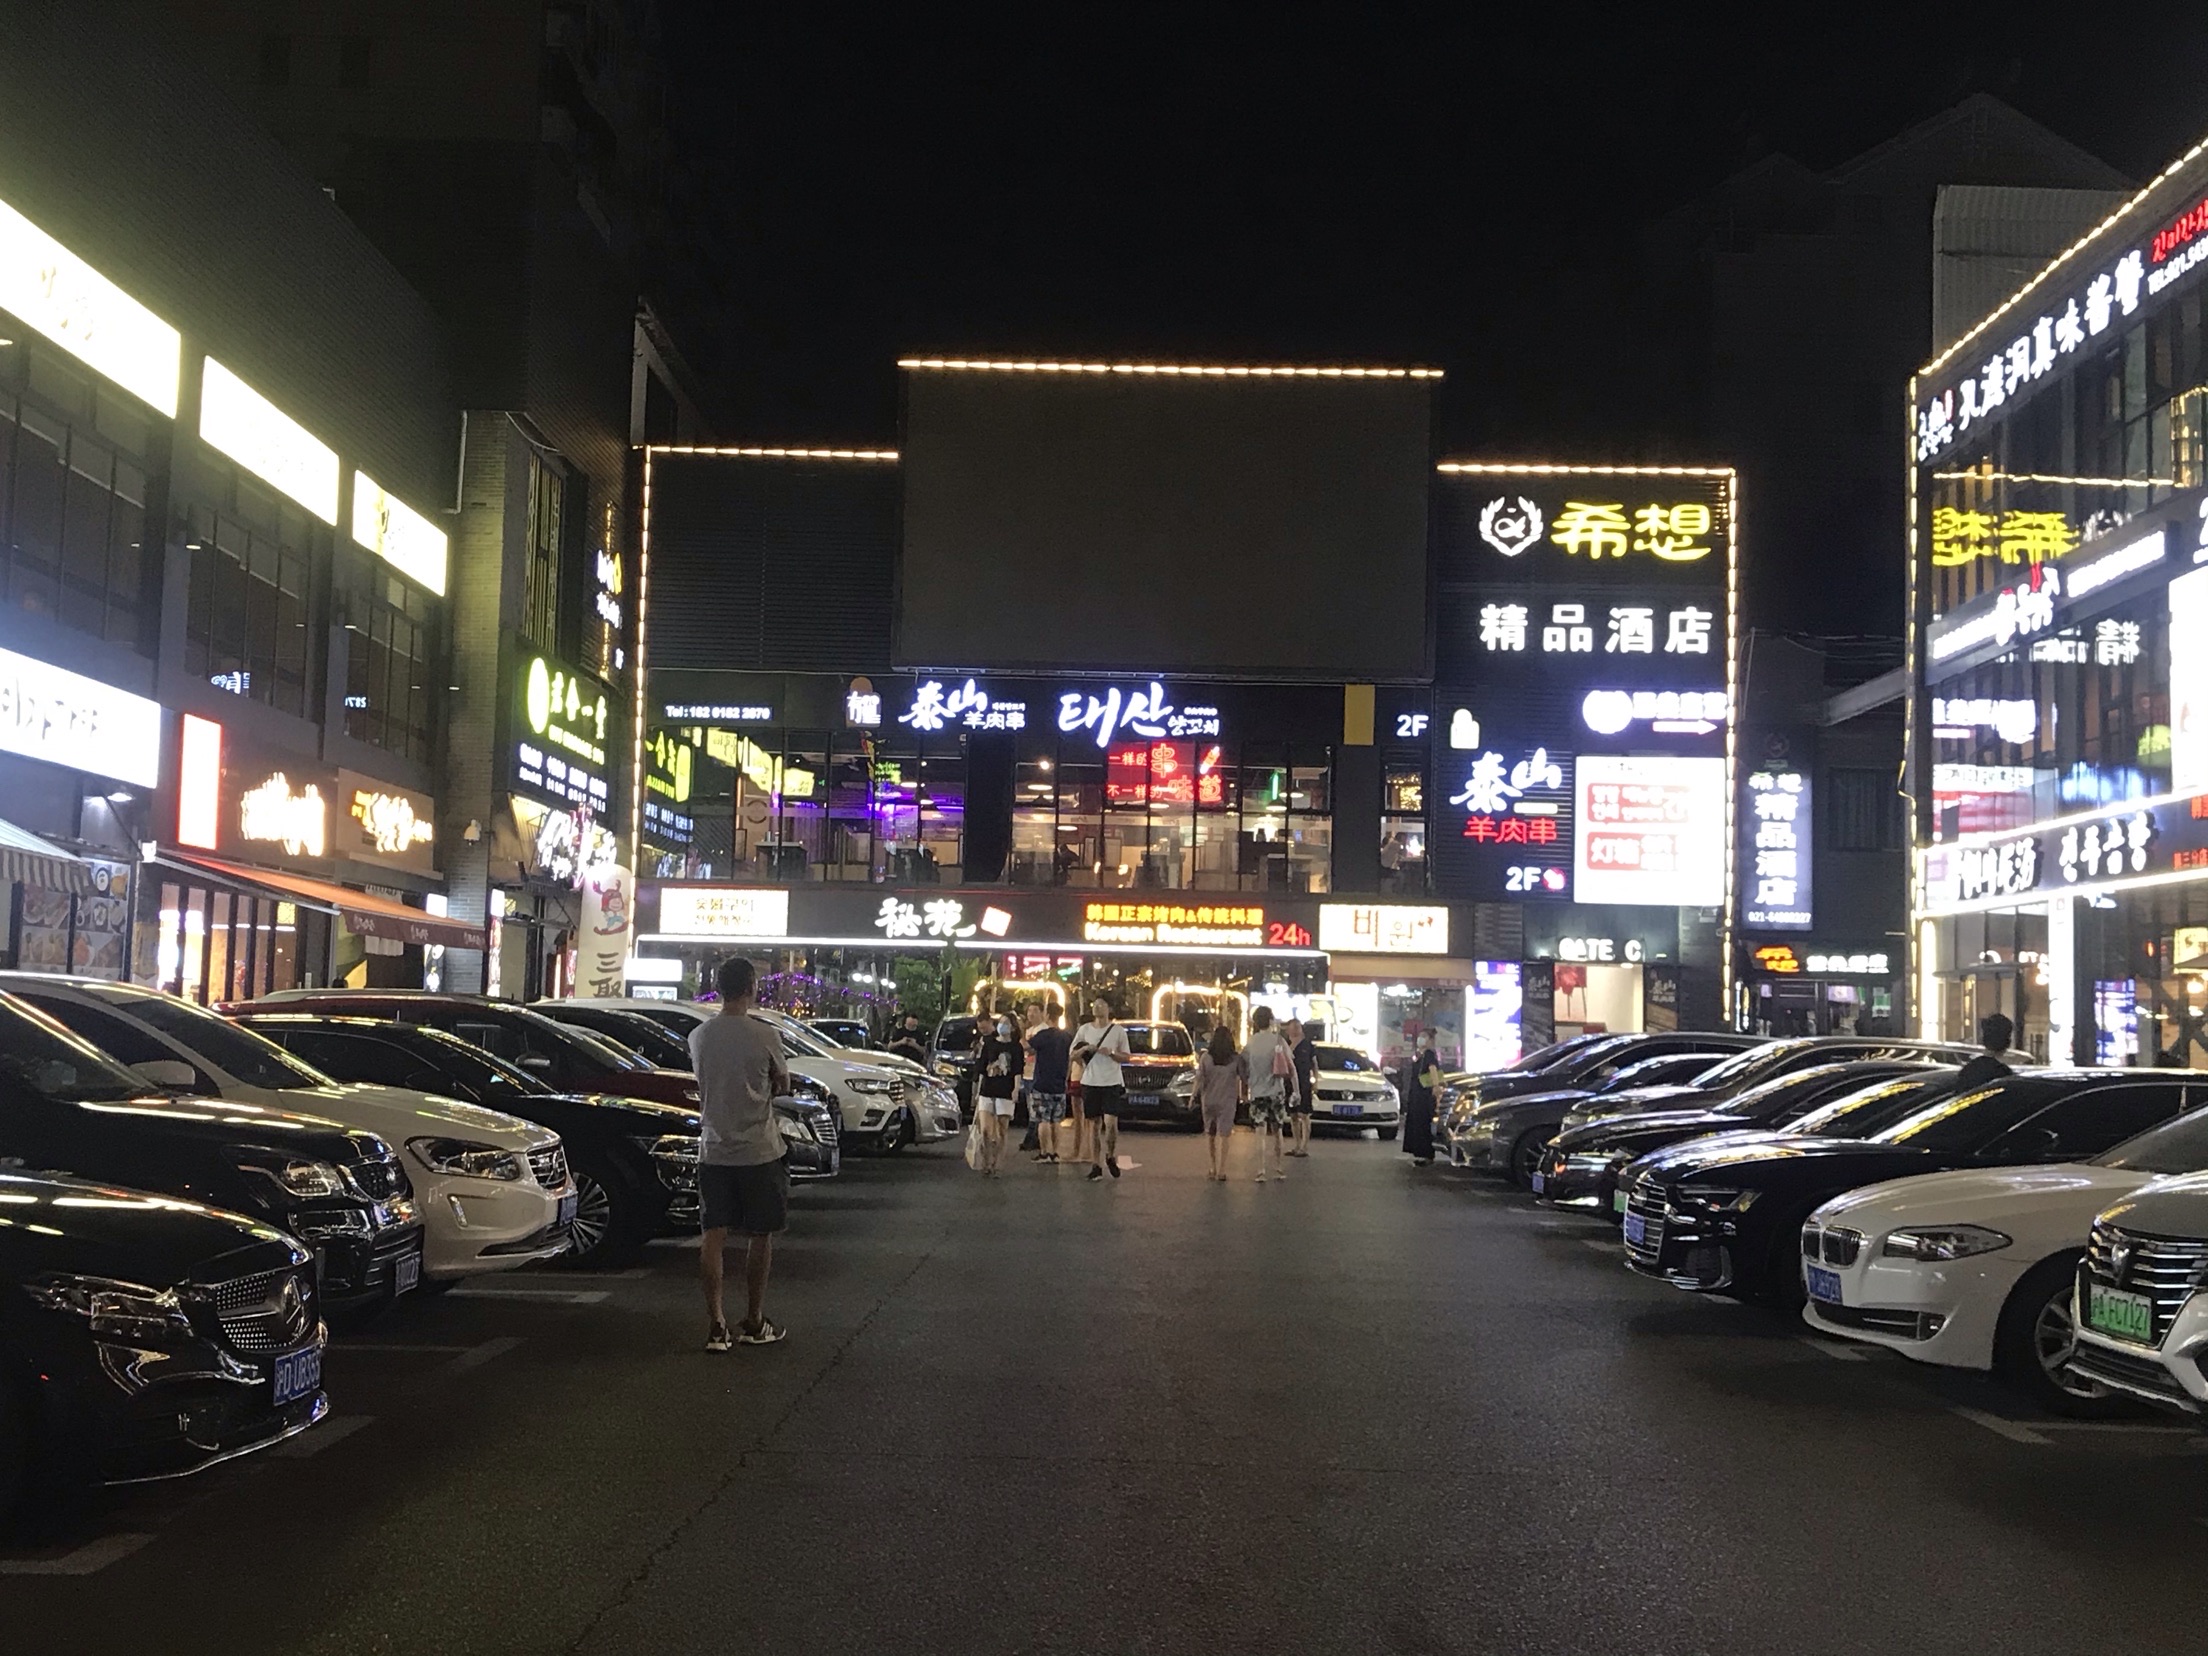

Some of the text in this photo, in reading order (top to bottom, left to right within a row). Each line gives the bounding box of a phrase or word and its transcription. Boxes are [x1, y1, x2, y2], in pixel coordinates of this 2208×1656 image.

[1551, 502, 1711, 560] 希想
[1480, 603, 1712, 653] 精品酒店
[898, 679, 988, 730] 泰山
[1058, 682, 1173, 748] 태산
[963, 711, 1026, 730] 羊肉串
[1397, 715, 1429, 737] 2F
[1450, 747, 1562, 813] 泰山
[1463, 816, 1558, 845] 羊肉串
[1506, 867, 1540, 892] 2F
[1084, 922, 1311, 946] Korean Restaurant 24h
[1559, 937, 1642, 962] GATE C
